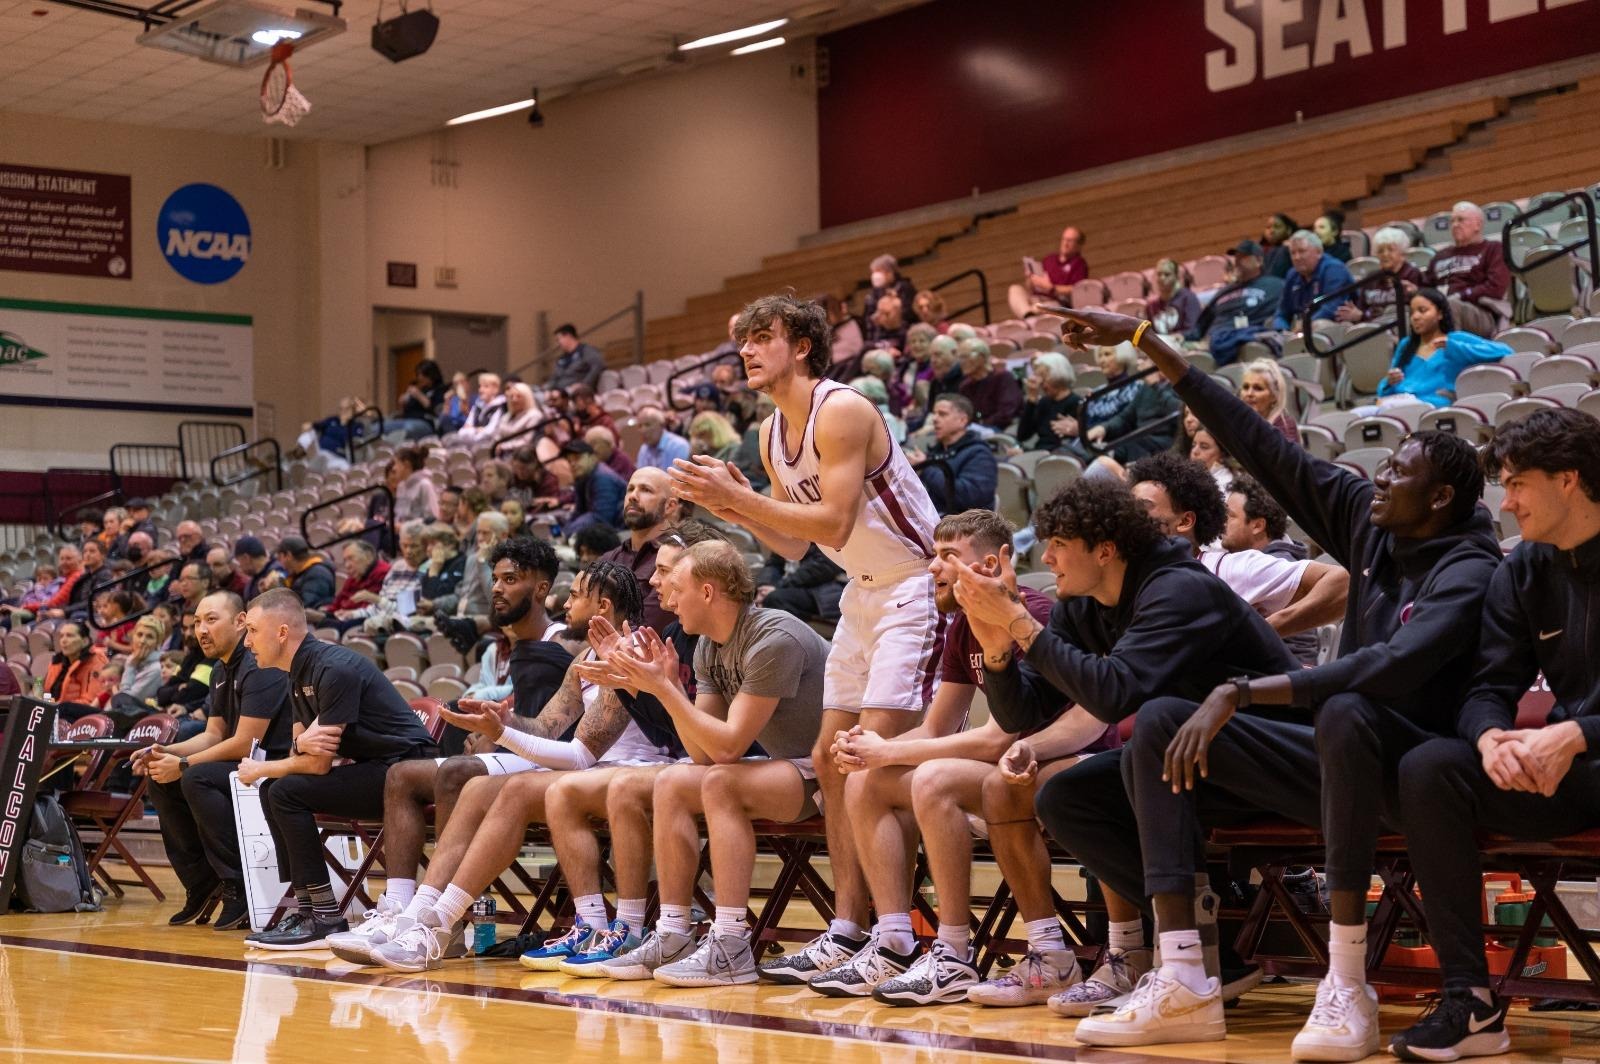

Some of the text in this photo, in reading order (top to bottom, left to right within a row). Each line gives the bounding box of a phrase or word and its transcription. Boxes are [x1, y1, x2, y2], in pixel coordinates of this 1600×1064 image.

[1205, 0, 1592, 92] SEAT
[37, 175, 97, 195] STATEMENT
[166, 228, 248, 261] NCAA
[128, 724, 161, 742] FALCONS
[0, 706, 44, 890] FALCON
